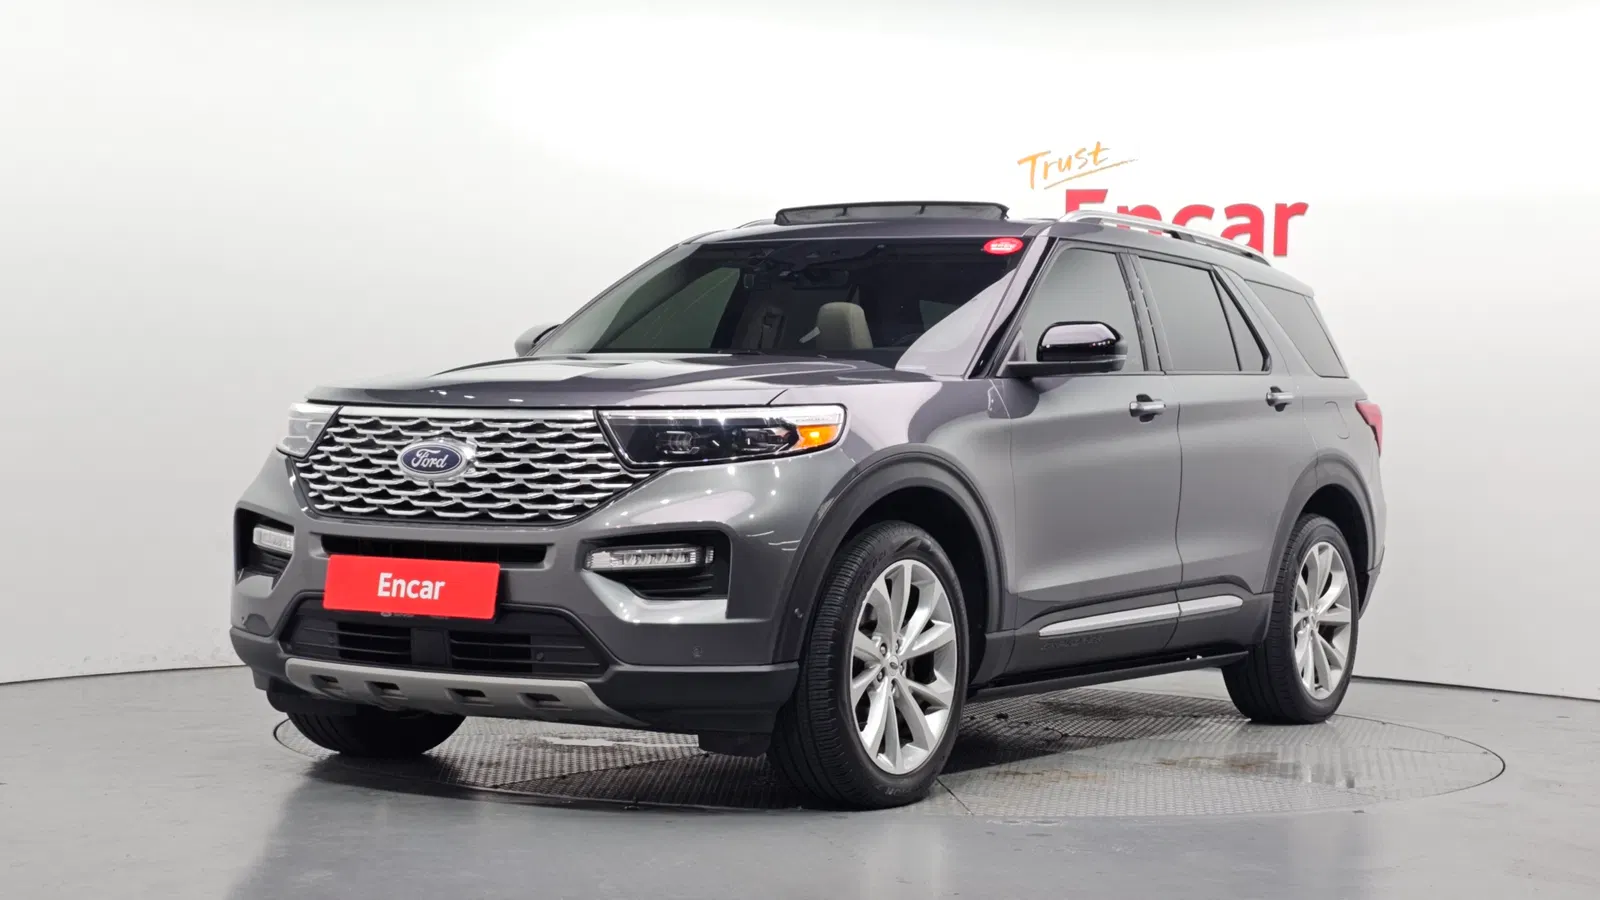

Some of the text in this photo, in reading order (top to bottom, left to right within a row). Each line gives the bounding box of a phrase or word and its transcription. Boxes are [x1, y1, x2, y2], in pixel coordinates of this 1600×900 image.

[1017, 141, 1110, 190] Trust
[411, 448, 449, 468] Ford
[377, 572, 446, 600] Encar
